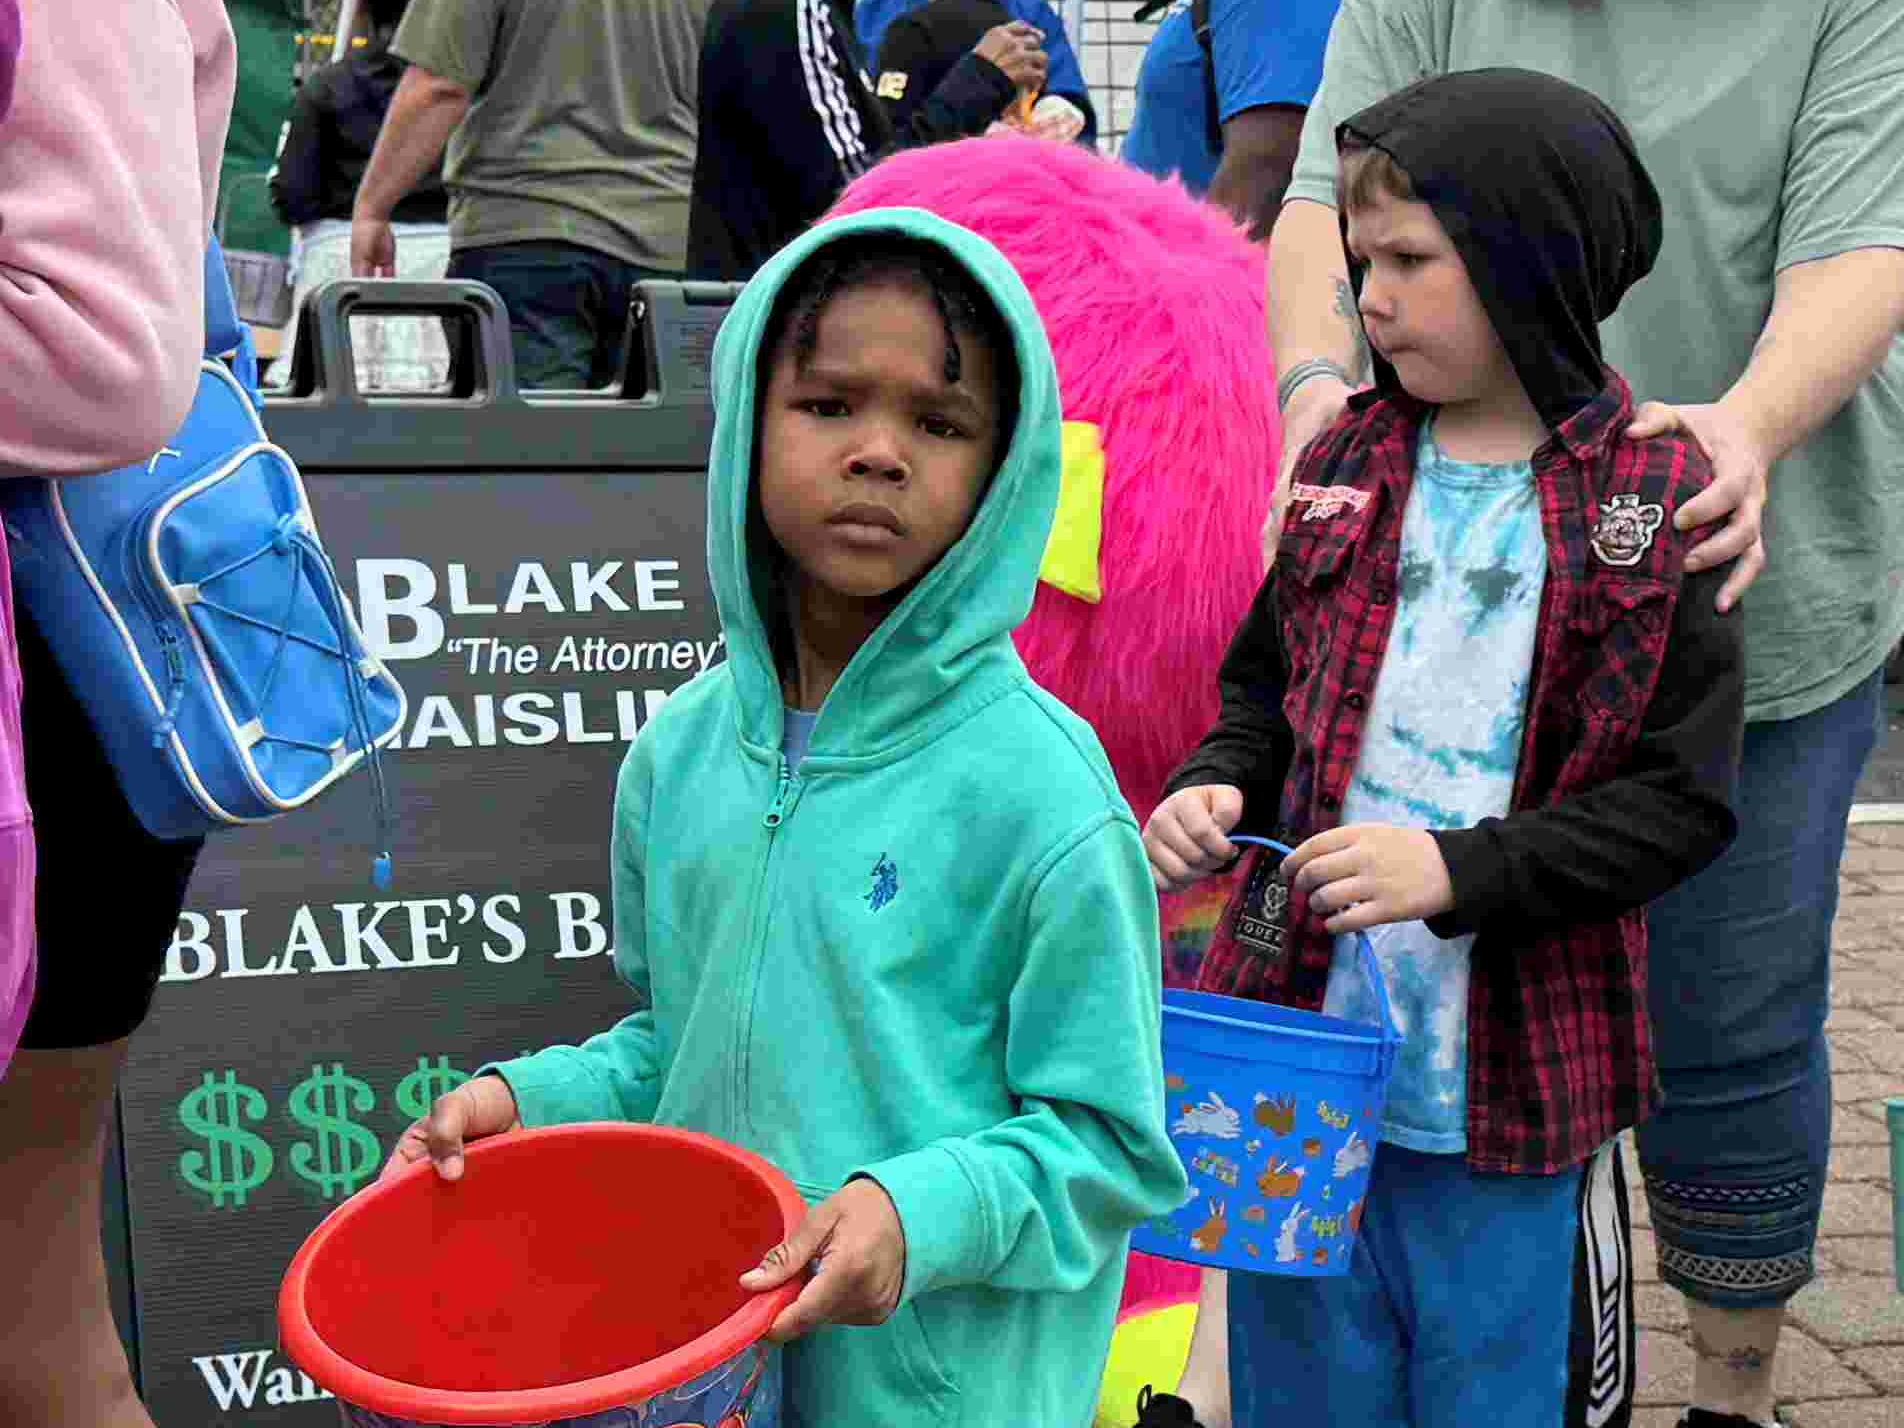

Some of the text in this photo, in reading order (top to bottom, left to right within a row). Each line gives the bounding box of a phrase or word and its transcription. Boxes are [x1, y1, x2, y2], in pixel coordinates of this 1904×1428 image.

[356, 557, 686, 662] BLAKE
[386, 688, 676, 749] AISLI
[159, 894, 527, 983] BLAKE’S
